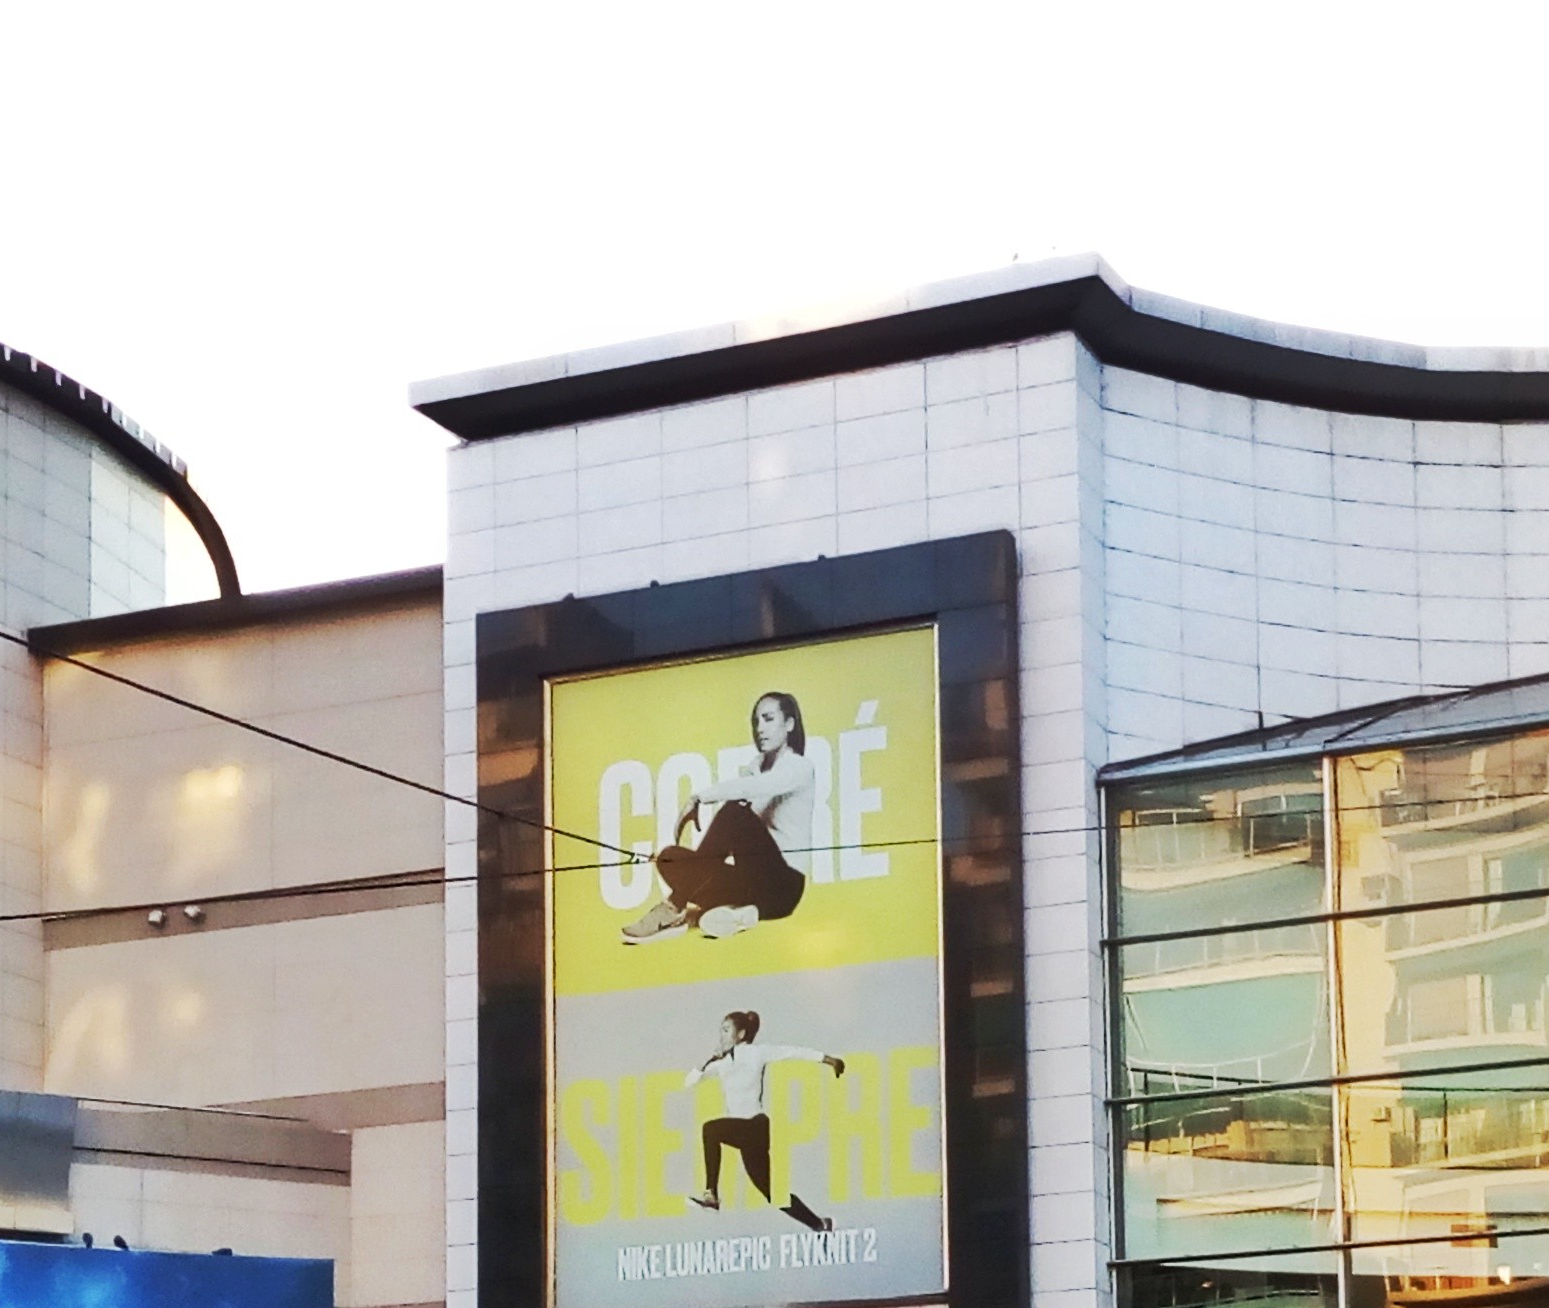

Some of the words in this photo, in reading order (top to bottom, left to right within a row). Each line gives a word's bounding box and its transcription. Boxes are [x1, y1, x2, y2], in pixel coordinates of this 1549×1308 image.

[617, 1245, 664, 1282] NIKE
[664, 1235, 771, 1277] LUNAREPIC
[779, 1228, 858, 1270] FLYKNIT
[862, 1227, 877, 1263] 2
